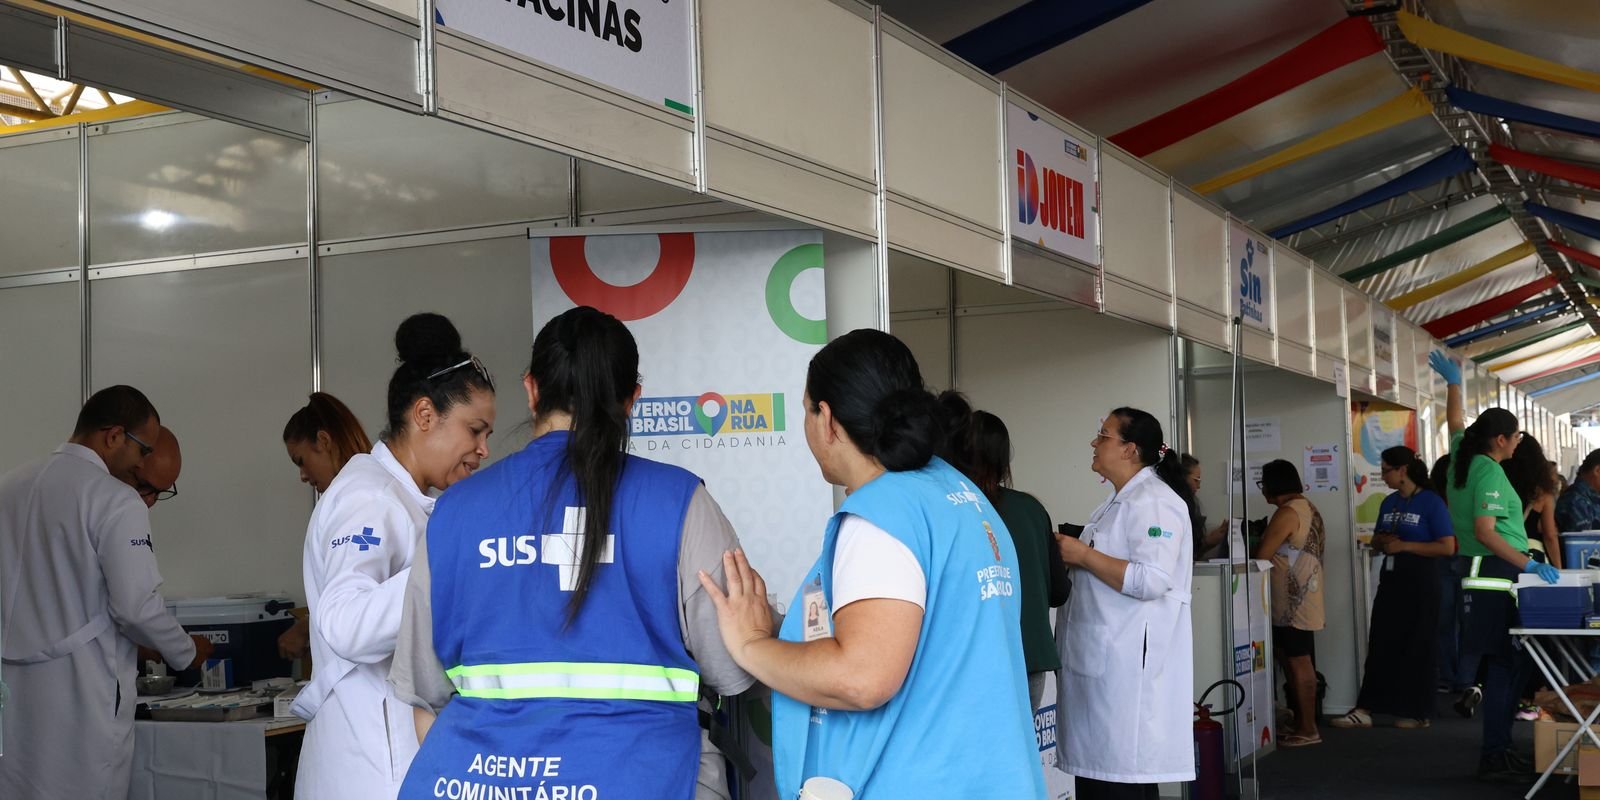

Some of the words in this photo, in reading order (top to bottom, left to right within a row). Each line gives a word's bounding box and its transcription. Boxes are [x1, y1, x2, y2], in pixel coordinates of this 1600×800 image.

[1039, 167, 1085, 240] JOVEM
[1240, 258, 1262, 305] Sin
[631, 401, 692, 418] VERNO
[731, 399, 756, 414] NA
[632, 416, 694, 433] BRASIL
[731, 414, 768, 430] RUA
[647, 439, 671, 451] DA
[681, 435, 787, 450] CIDADANIA
[130, 538, 147, 546] SUS
[331, 535, 351, 549] SUS
[478, 535, 537, 569] SUS
[1034, 710, 1057, 732] OVER
[1042, 726, 1057, 747] BRA
[467, 753, 562, 778] AGENTE
[434, 776, 598, 800] COMUNITÁRIO
